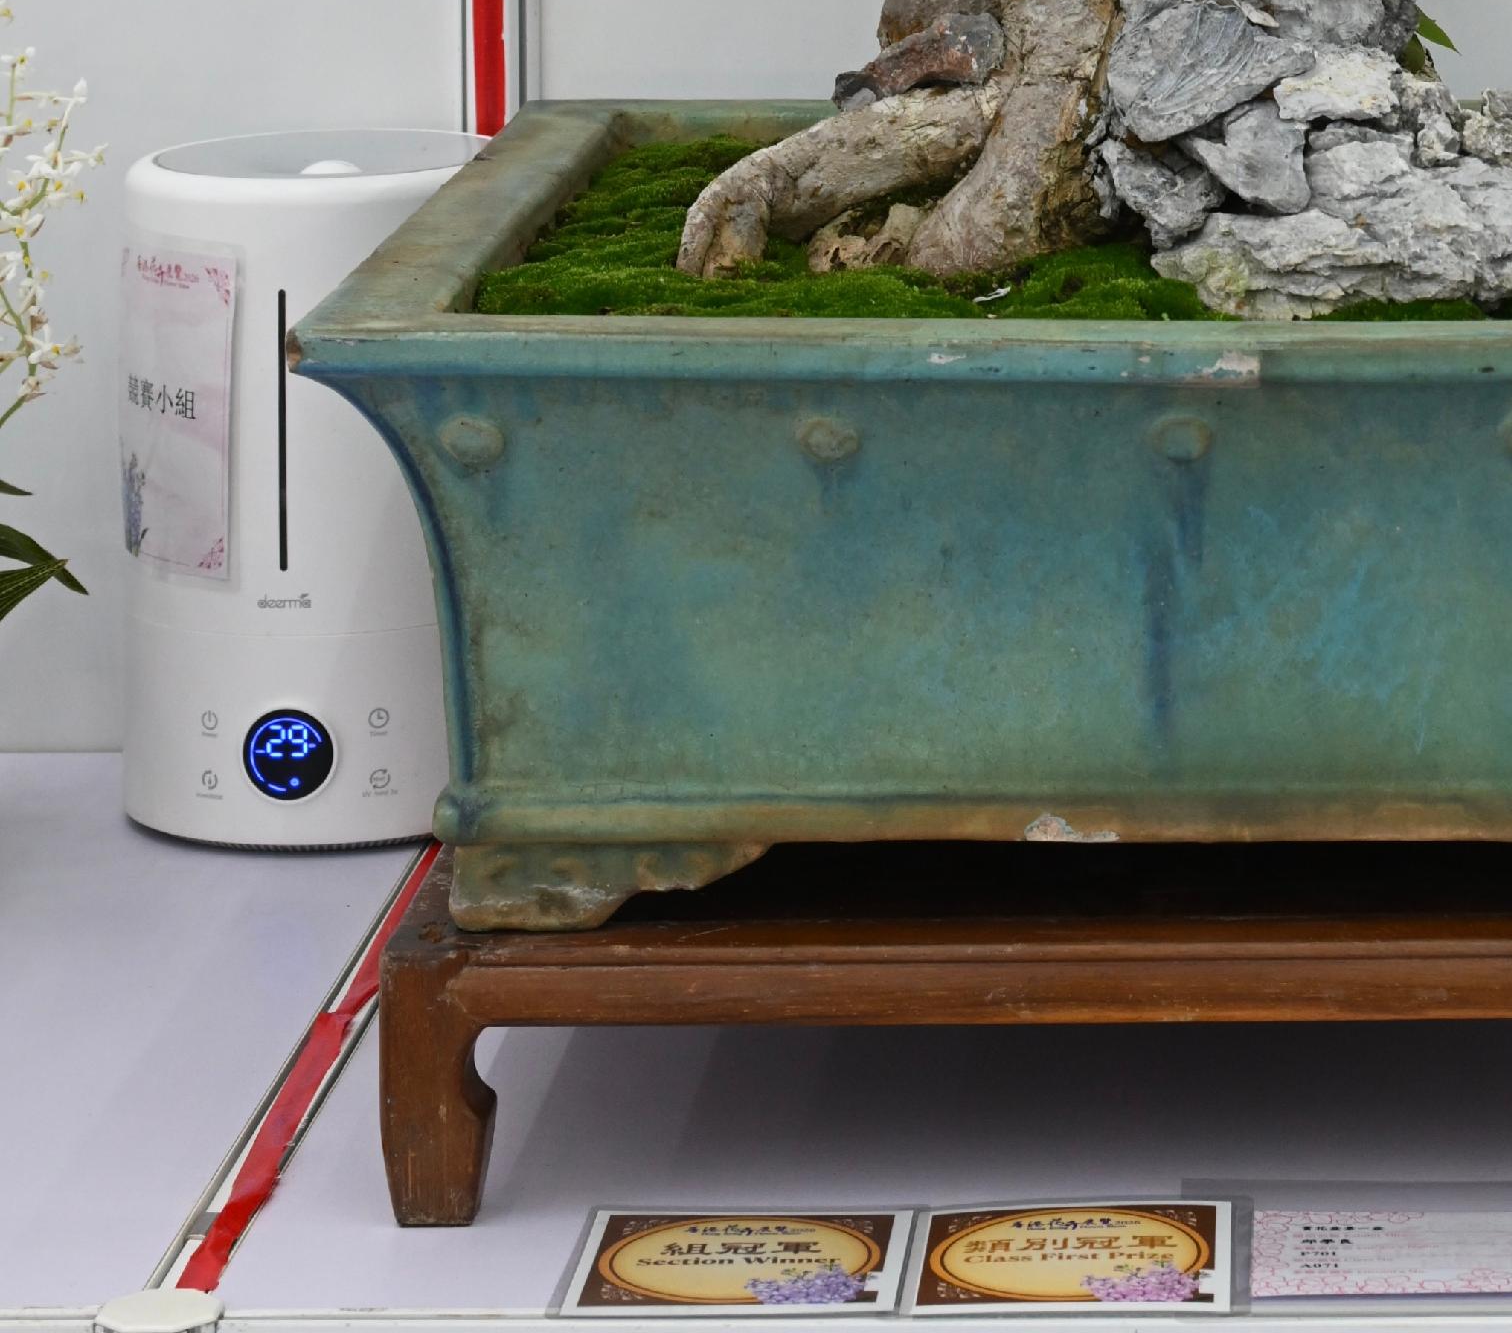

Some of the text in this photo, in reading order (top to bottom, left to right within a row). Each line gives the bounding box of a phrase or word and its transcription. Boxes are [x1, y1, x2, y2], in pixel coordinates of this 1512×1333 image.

[265, 725, 308, 757] 29
[660, 1241, 822, 1256] 組冠軍
[963, 1235, 1178, 1254] 類別冠軍
[636, 1255, 841, 1267] Section Winner
[964, 1251, 1175, 1263] Class First Prize
